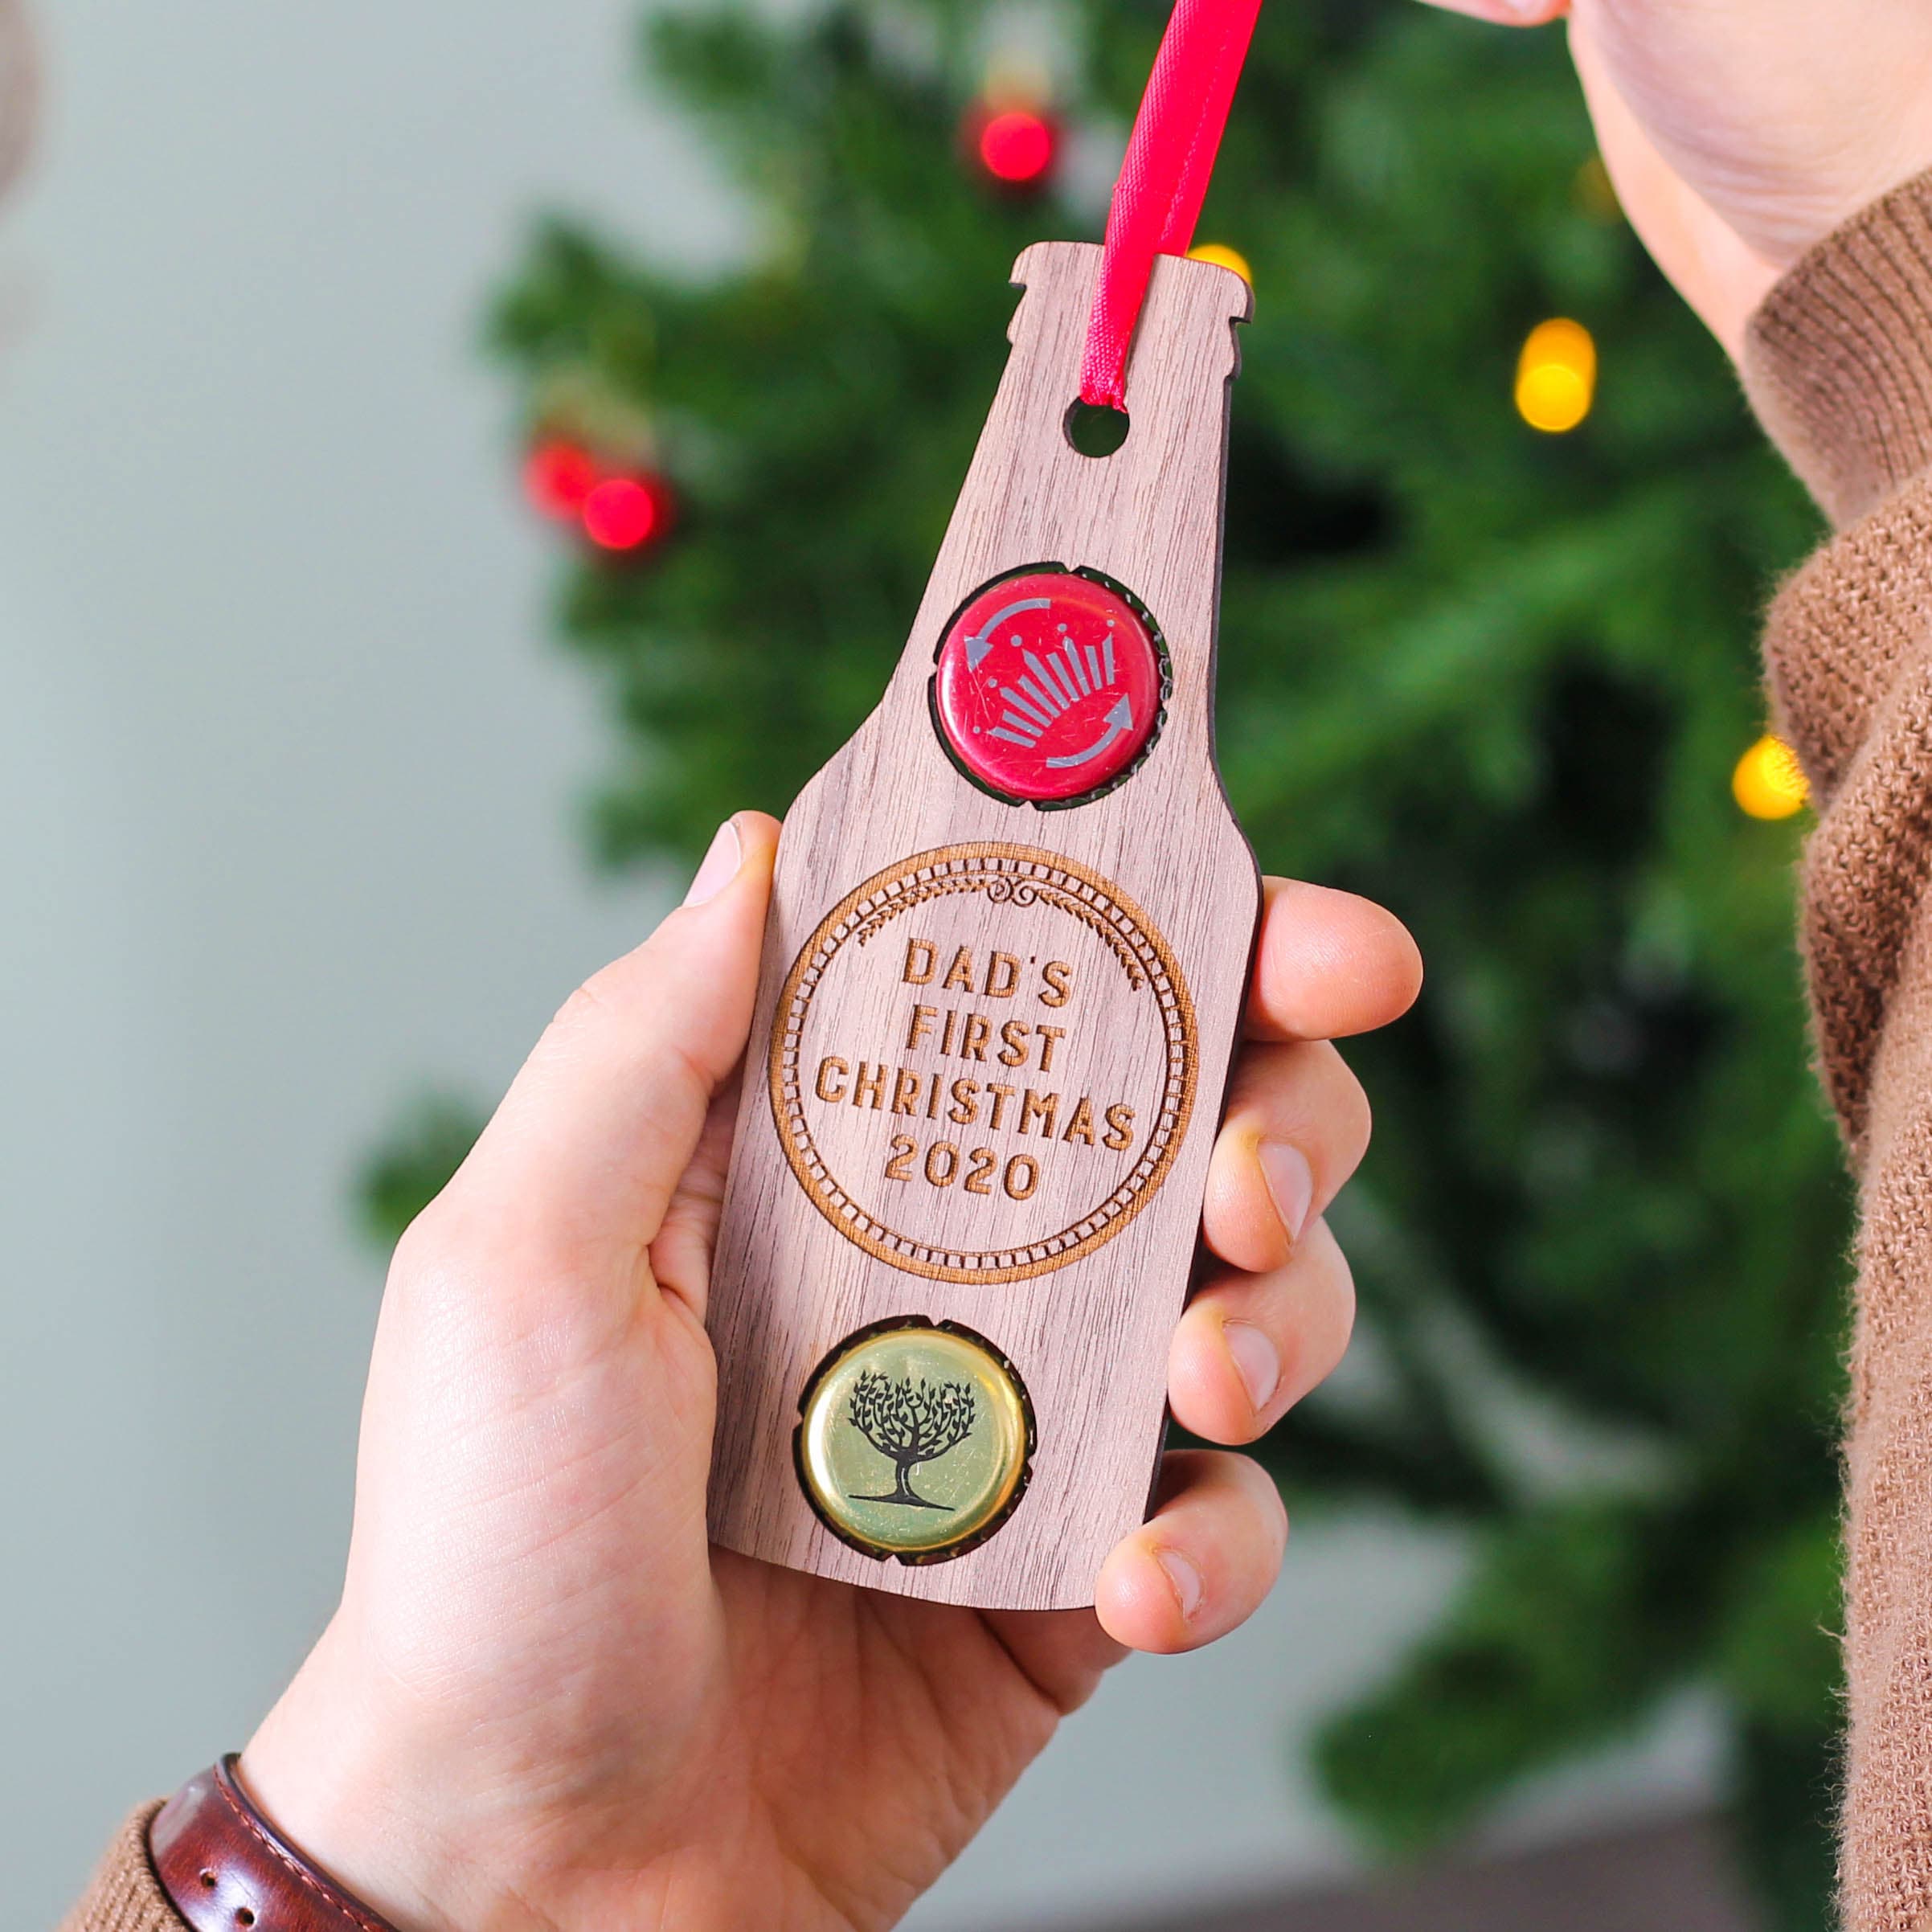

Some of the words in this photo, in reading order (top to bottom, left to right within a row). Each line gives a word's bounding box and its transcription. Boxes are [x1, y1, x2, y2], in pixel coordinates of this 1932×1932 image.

[902, 938, 1072, 1007] DAD'S
[906, 1005, 1066, 1072] FIRST
[815, 1056, 1136, 1152] CHRISTMAS
[885, 1134, 1040, 1201] 2020
